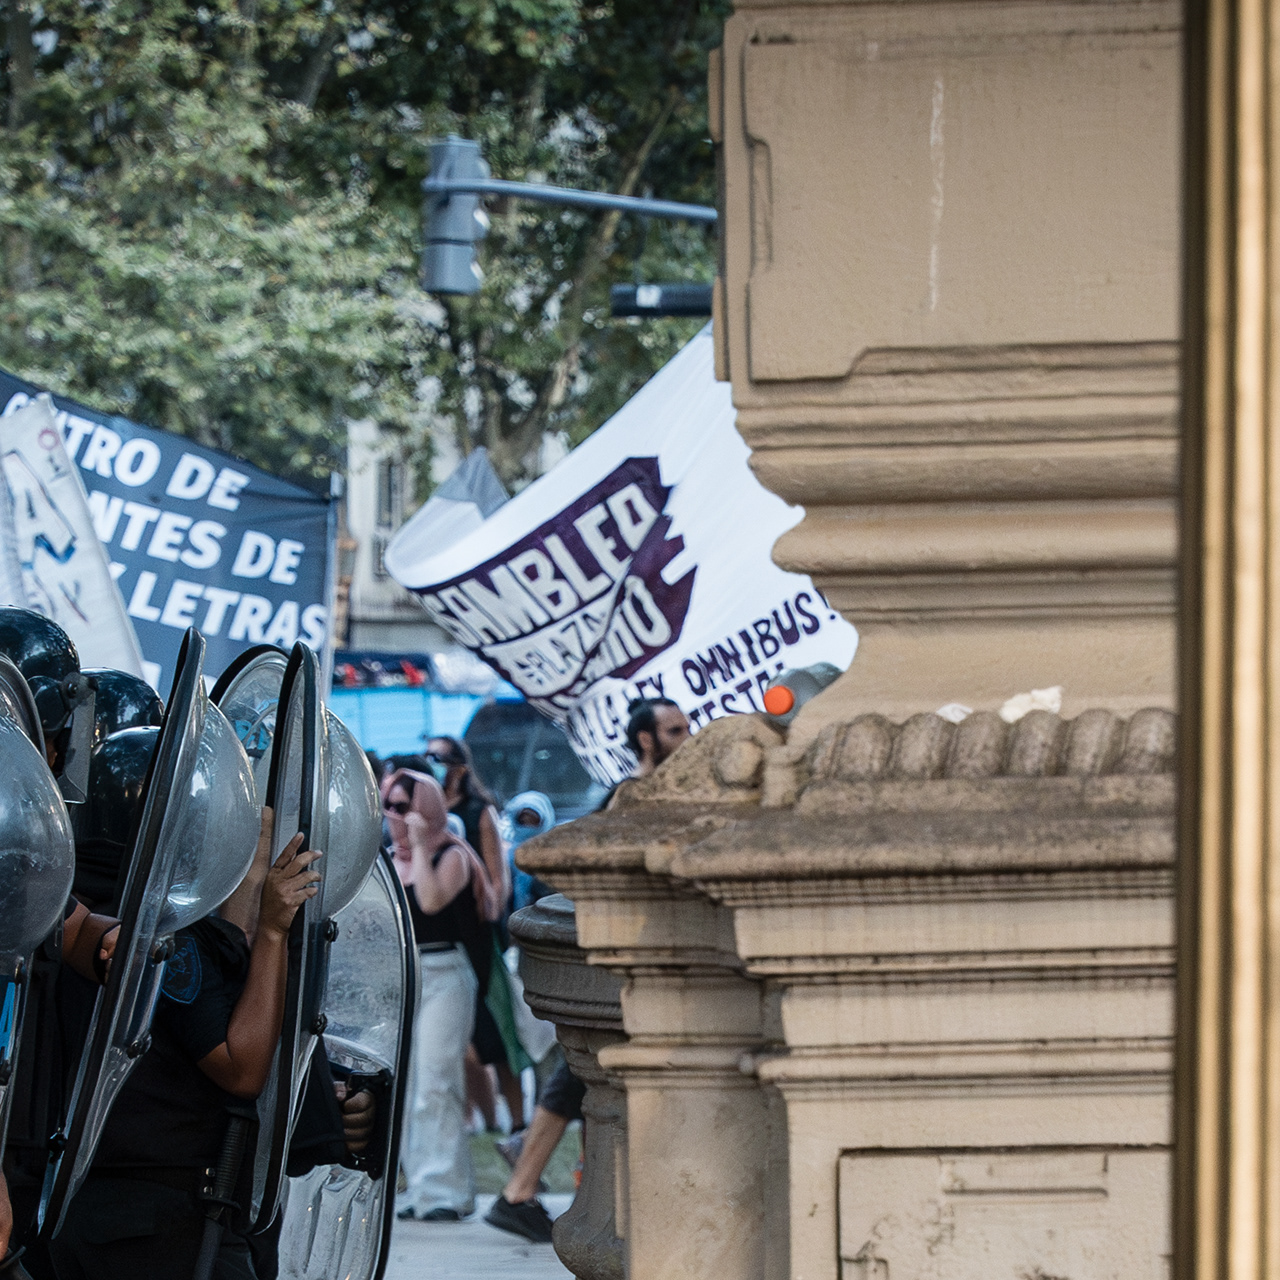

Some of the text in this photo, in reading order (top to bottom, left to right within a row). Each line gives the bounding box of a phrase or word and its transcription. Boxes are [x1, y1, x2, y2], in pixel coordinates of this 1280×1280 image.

[166, 452, 251, 511] DE
[87, 490, 228, 569] NTES
[232, 530, 306, 585] DE
[127, 571, 328, 650] LETRAS
